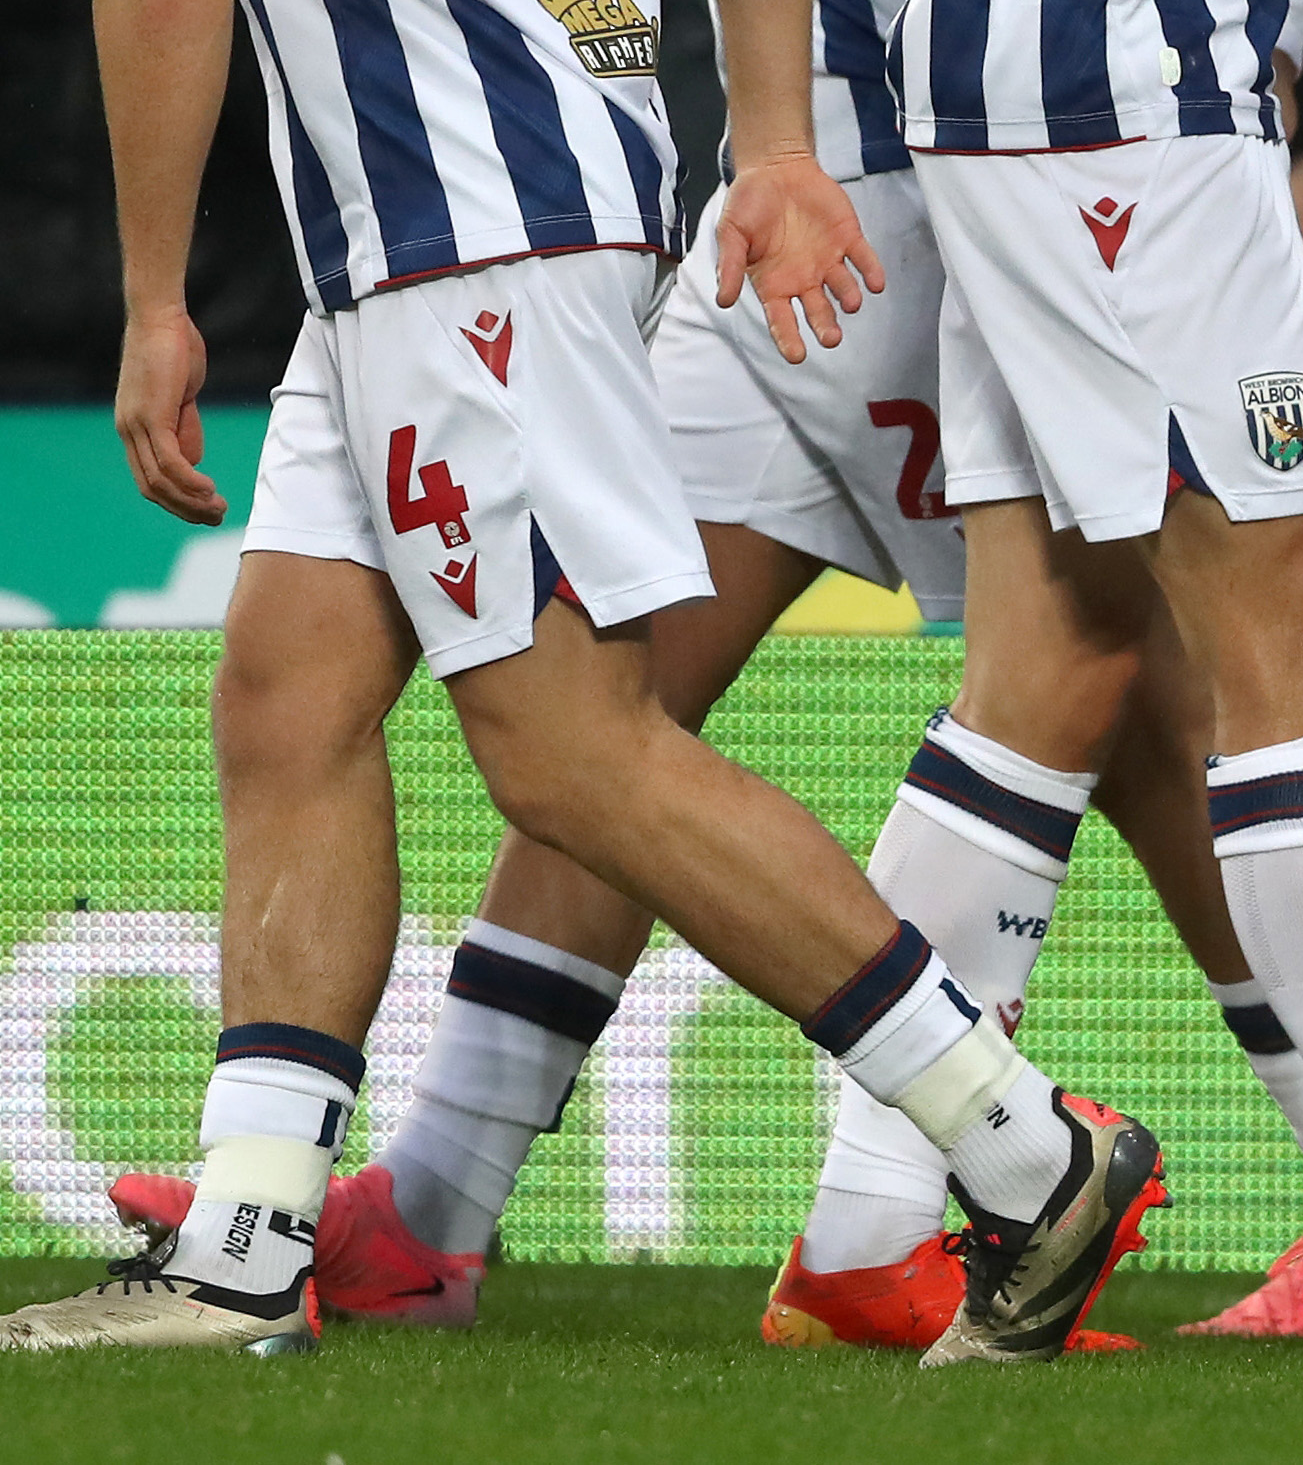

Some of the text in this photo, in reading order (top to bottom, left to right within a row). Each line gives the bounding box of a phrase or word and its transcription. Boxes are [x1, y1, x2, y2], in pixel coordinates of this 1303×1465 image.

[579, 35, 654, 70] RICHES
[386, 424, 472, 550] 4
[867, 398, 961, 520] 2
